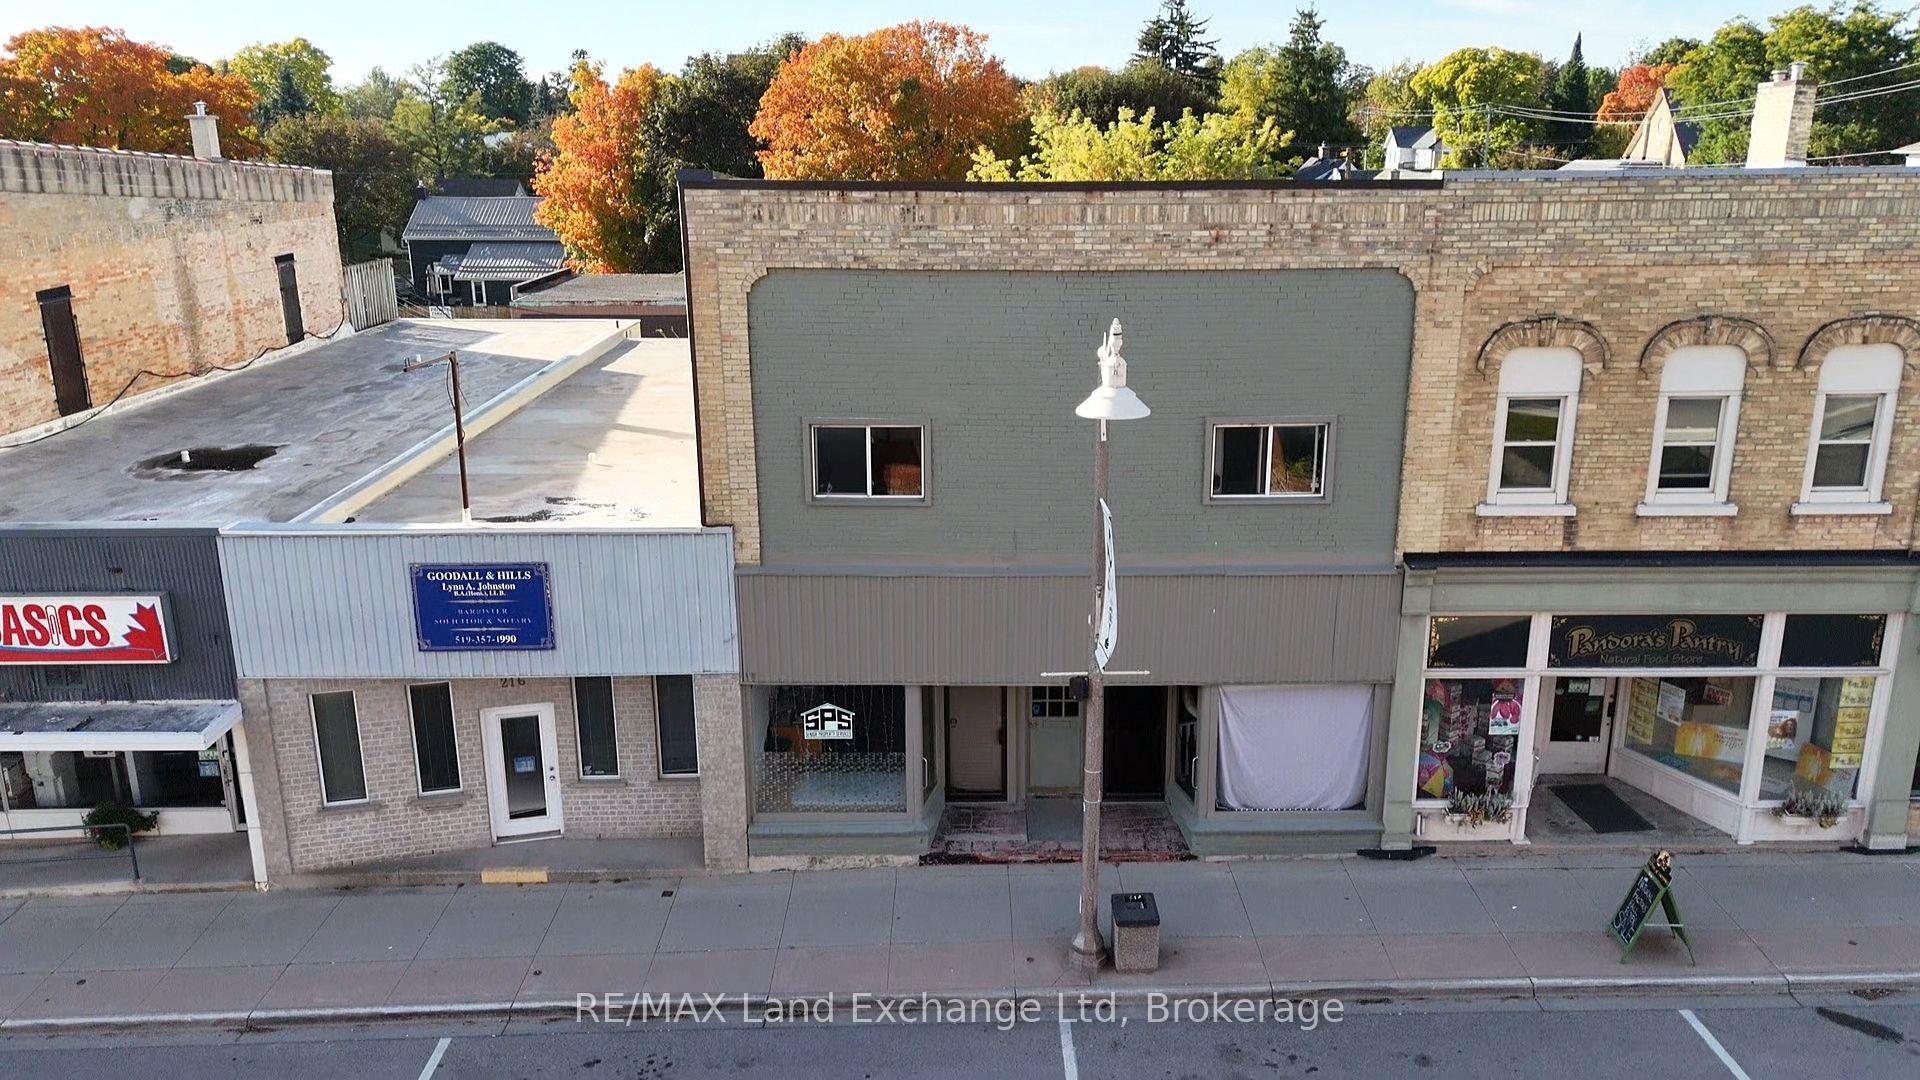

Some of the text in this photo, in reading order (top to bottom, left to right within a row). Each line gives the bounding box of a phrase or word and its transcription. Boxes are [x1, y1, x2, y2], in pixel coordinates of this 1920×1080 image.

[427, 571, 532, 581] GOODALL & HILLS
[442, 582, 516, 592] Lynn A. Johnston
[0, 604, 110, 647] ASICS
[455, 634, 517, 644] 519-357-1990
[1565, 618, 1744, 661] Pandora's Pantry
[1600, 653, 1704, 664] Natural Food Store
[500, 677, 526, 688] 216
[806, 708, 851, 730] SPS
